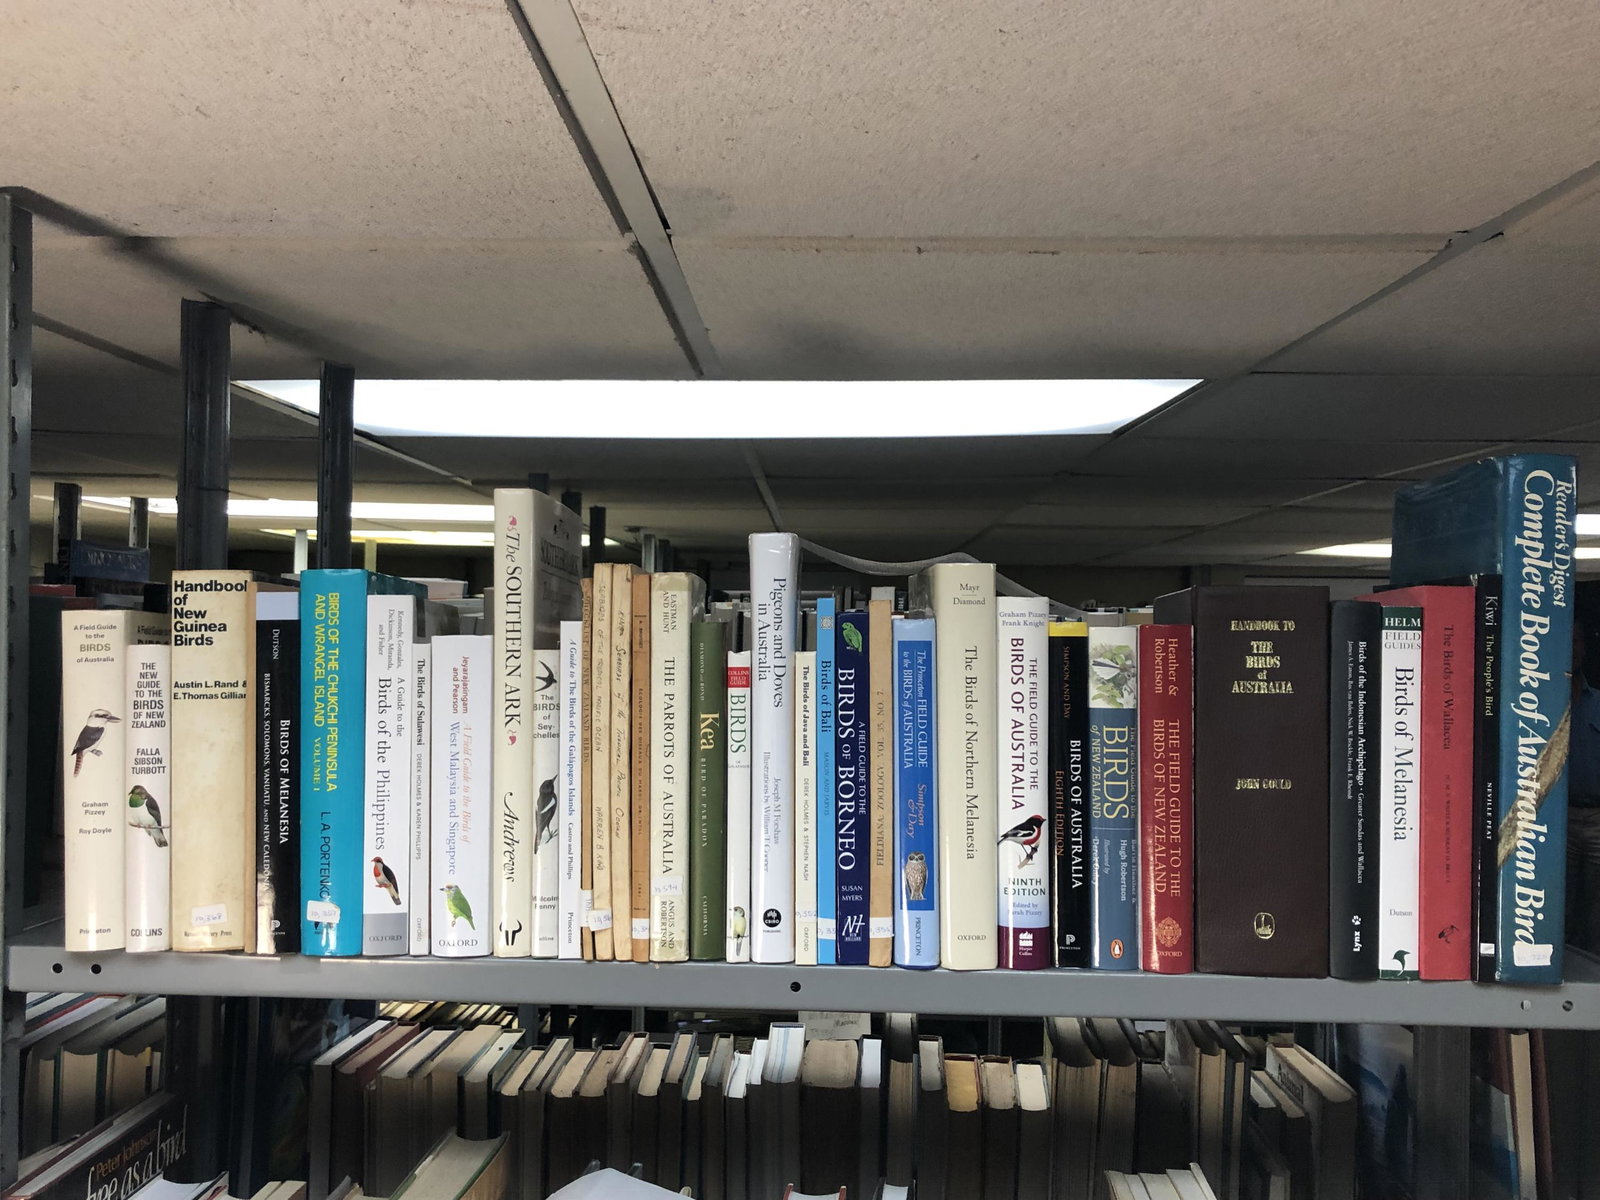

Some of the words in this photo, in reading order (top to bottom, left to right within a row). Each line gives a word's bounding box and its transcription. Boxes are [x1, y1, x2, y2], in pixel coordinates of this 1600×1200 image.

[1555, 479, 1573, 550] Reader's
[506, 533, 520, 562] The
[1515, 469, 1555, 609] Complete
[1549, 552, 1571, 608] Digest
[174, 593, 188, 608] of
[174, 607, 207, 621] New
[314, 593, 325, 620] AND
[328, 592, 339, 626] BIRDS
[758, 603, 771, 615] in
[769, 578, 786, 631] Pigeons
[1485, 596, 1498, 625] Kiwi
[174, 620, 227, 633] Guinea
[328, 628, 339, 645] OF
[505, 566, 522, 678] SOUTHERN
[1385, 617, 1421, 627] HELM
[80, 643, 111, 652] BIRDS
[174, 634, 213, 646] Birds
[314, 623, 325, 682] WRANGEL
[758, 619, 771, 681] Australia
[774, 635, 786, 659] and
[1251, 641, 1273, 653] THE
[1359, 641, 1367, 663] Birds
[1486, 635, 1494, 653] The
[1519, 610, 1551, 688] Book
[141, 662, 156, 670] THE
[328, 648, 339, 671] THE
[417, 658, 425, 674] The
[664, 657, 675, 686] THE
[903, 659, 911, 668] the
[917, 651, 926, 664] The
[965, 645, 978, 671] The
[1011, 638, 1024, 685] BIRDS
[1154, 638, 1166, 694] Robertson
[1168, 638, 1179, 682] Heather
[1246, 655, 1281, 669] BIRDS
[1359, 665, 1367, 674] of
[136, 681, 160, 689] GUIDE
[417, 676, 425, 698] Birds
[569, 680, 577, 696] The
[773, 663, 787, 708] Doves
[821, 660, 832, 690] Birds
[903, 669, 913, 700] BIRDS
[916, 665, 926, 698] Princeton
[1232, 681, 1294, 694] AUSTRALIA
[1358, 676, 1367, 688] the
[1484, 656, 1494, 693] People's
[133, 700, 164, 710] BIRDS
[135, 690, 144, 698] TO
[148, 689, 162, 697] THE
[327, 674, 339, 724] CHUKCHI
[378, 678, 392, 714] Birds
[417, 701, 425, 709] of
[505, 683, 521, 727] ARK
[821, 694, 832, 706] of
[838, 668, 855, 738] BIRDS
[902, 700, 912, 708] of
[965, 676, 978, 709] Birds
[1011, 691, 1024, 714] OF
[1168, 685, 1179, 696] &
[1395, 667, 1414, 715] Birds
[133, 711, 142, 719] OF
[145, 711, 165, 719] NEW
[314, 685, 325, 727] ISLAND
[803, 704, 809, 713] of
[917, 699, 928, 729] FIELD
[965, 713, 978, 727] of
[1358, 691, 1366, 735] Indonesian
[1485, 696, 1493, 716] Bird
[1511, 691, 1551, 727] of
[131, 720, 166, 729] ZEALAND
[378, 720, 392, 737] of
[417, 710, 425, 745] Sulawesi
[450, 721, 460, 747] West
[569, 720, 576, 729] of
[664, 693, 675, 758] PARROTS
[700, 713, 719, 751] Kea
[730, 694, 746, 753] BIRDS
[821, 710, 832, 732] Bali
[1089, 724, 1101, 735] of
[1395, 721, 1414, 741] of
[280, 720, 290, 755] BIRDS
[377, 740, 391, 763] the
[842, 744, 851, 759] OF
[903, 709, 914, 769] AUSTRALIA
[918, 731, 928, 768] GUIDE
[1092, 738, 1101, 764] NEW
[1153, 720, 1165, 759] BIRDS
[280, 758, 289, 774] OF
[326, 727, 338, 792] PENINSULA
[446, 751, 460, 795] Malaysia
[567, 745, 576, 786] Galápagos
[663, 764, 674, 784] OF
[966, 730, 979, 789] Northern
[1011, 719, 1025, 810] AUSTRALIA
[1070, 740, 1081, 782] BIRDS
[1103, 726, 1129, 819] BIRDS
[1153, 763, 1165, 782] OF
[1356, 737, 1366, 786] Archipelago
[568, 788, 576, 816] Islands
[1071, 786, 1082, 804] OF
[1092, 766, 1101, 818] ZEALAND
[1154, 787, 1165, 821] NEW
[1394, 745, 1413, 841] Melanesia
[1515, 720, 1548, 881] Australian
[279, 778, 290, 844] MELANESIA
[372, 770, 391, 850] Philippines
[449, 799, 460, 818] and
[838, 766, 855, 870] BORNEO
[503, 792, 520, 882] Andrews
[662, 792, 674, 874] AUSTRALIA
[966, 794, 979, 859] Melanesia
[445, 821, 459, 875] Singapore
[1071, 808, 1083, 888] AUSTRALIA
[1154, 825, 1167, 893] ZEALAND
